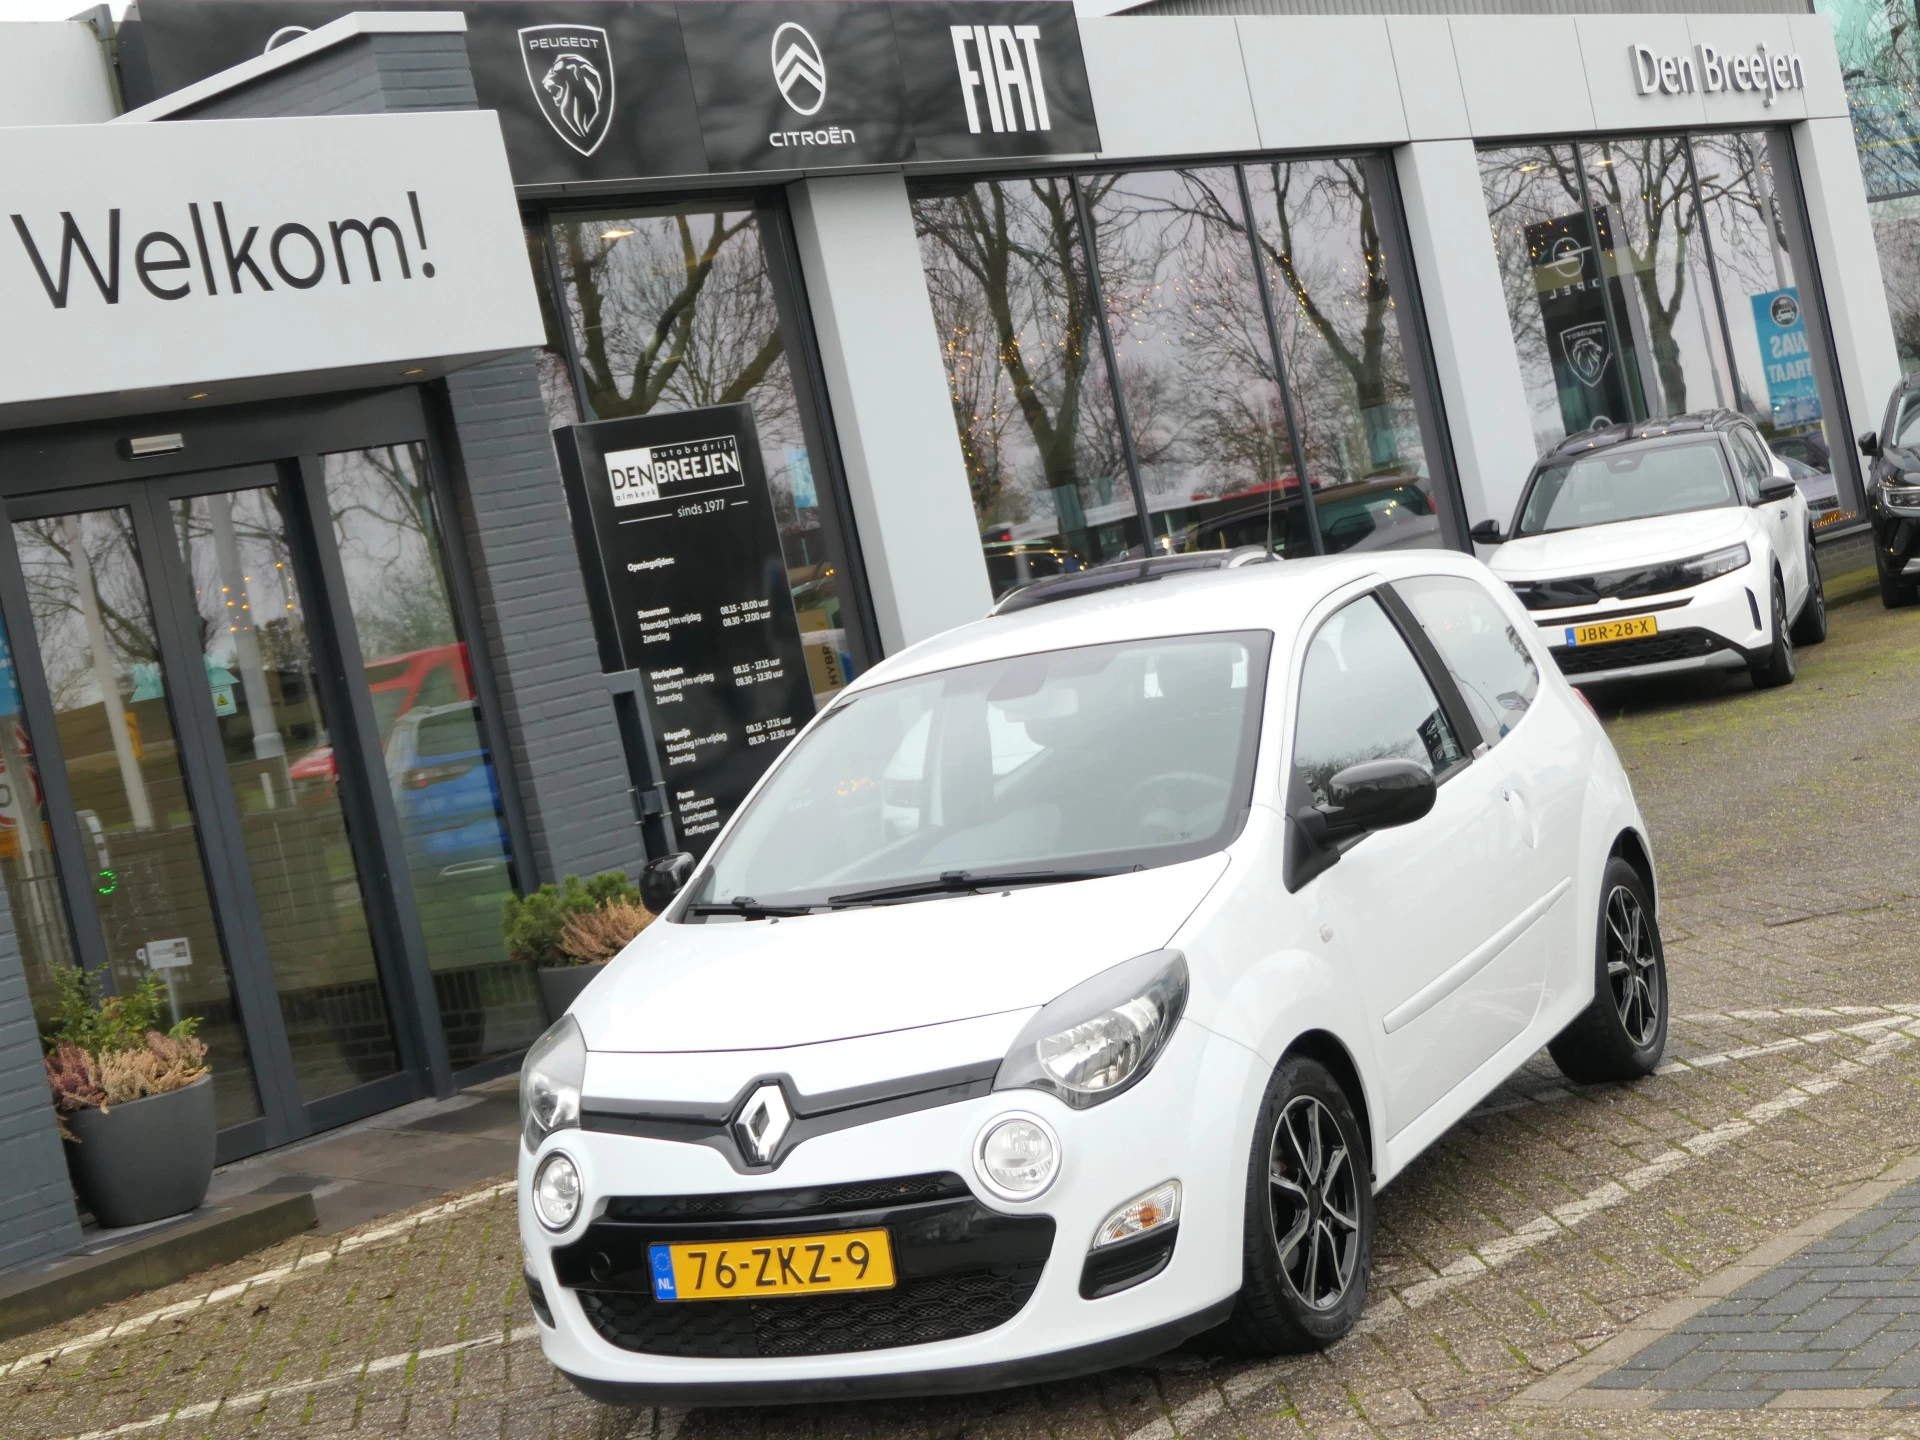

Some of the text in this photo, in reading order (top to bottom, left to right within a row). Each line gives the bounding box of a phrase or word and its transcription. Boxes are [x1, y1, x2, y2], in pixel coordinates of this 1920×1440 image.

[529, 37, 600, 50] PEUGEOT
[950, 25, 1051, 134] FIAT
[1628, 40, 1806, 107] Den Breejen
[10, 190, 436, 309] Welkom!
[652, 439, 734, 459] autobedrijf
[611, 451, 739, 490] DEN BREEJEN
[616, 489, 656, 501] almkerk
[677, 499, 725, 518] sinds 1977
[637, 607, 670, 619] Showroom
[720, 604, 737, 615] 08.15
[741, 600, 758, 611] 18.00
[758, 599, 769, 607] uur
[640, 613, 702, 631] Maandag t/m vrijdag
[723, 616, 740, 627] 08.30
[744, 612, 760, 623] 17.00
[760, 611, 771, 619] uur
[642, 632, 670, 643] Zaterdag
[1580, 619, 1649, 642] JBR-28-X
[650, 667, 684, 680] Werkplaats
[733, 664, 750, 674] 08.15
[755, 659, 769, 670] 17.15
[769, 658, 780, 666] uur
[653, 673, 714, 692] Maandag t/m vrijdag
[735, 676, 752, 686] 08.30
[756, 671, 772, 683] 12.30
[773, 670, 783, 678] uur
[655, 693, 683, 704] Zaterdag
[746, 723, 762, 734] 08.15
[766, 718, 780, 729] 17.15
[781, 717, 791, 725] uur
[664, 728, 691, 741] Magazijn
[666, 732, 727, 752] Maandag t/m vrijdag
[748, 735, 765, 746] 08.30
[769, 730, 785, 741] 12.30
[785, 728, 796, 737] uur
[668, 753, 696, 765] Zaterdag
[676, 790, 695, 800] Pauze
[679, 797, 715, 812] Koffiepauze
[681, 809, 718, 825] Lunchpauze
[684, 821, 720, 837] Koffiepauze
[658, 1240, 870, 1290] NL 76-ZKZ-9
